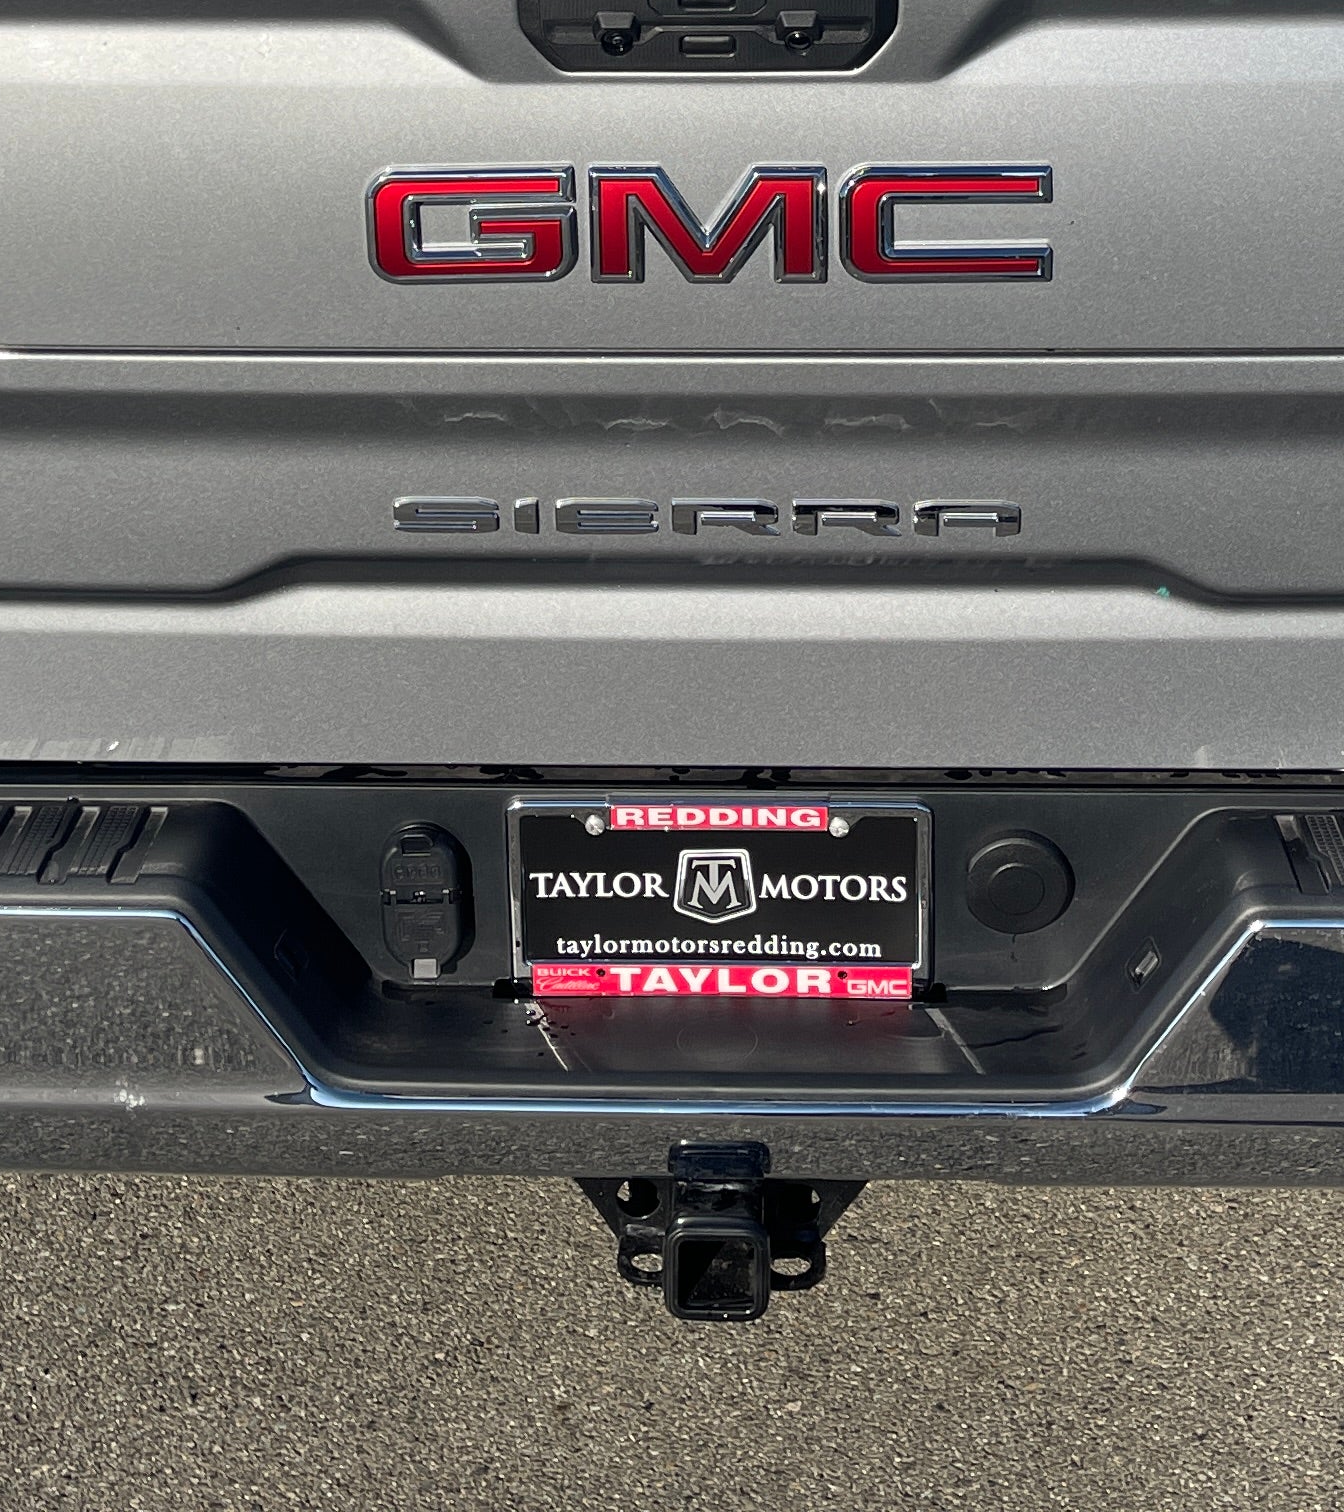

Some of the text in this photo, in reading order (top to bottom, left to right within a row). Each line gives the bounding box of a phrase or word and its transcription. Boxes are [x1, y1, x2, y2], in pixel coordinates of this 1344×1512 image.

[365, 162, 1053, 285] GMC
[392, 495, 1022, 538] SIERRA
[616, 807, 822, 828] REDDING
[529, 871, 670, 900] TAYLOR
[758, 873, 908, 902] MOTORS
[556, 933, 883, 959] taylormotorsredding.com
[537, 967, 591, 977] BUICK
[610, 967, 832, 995] TAYLOR
[847, 979, 909, 996] GMC
